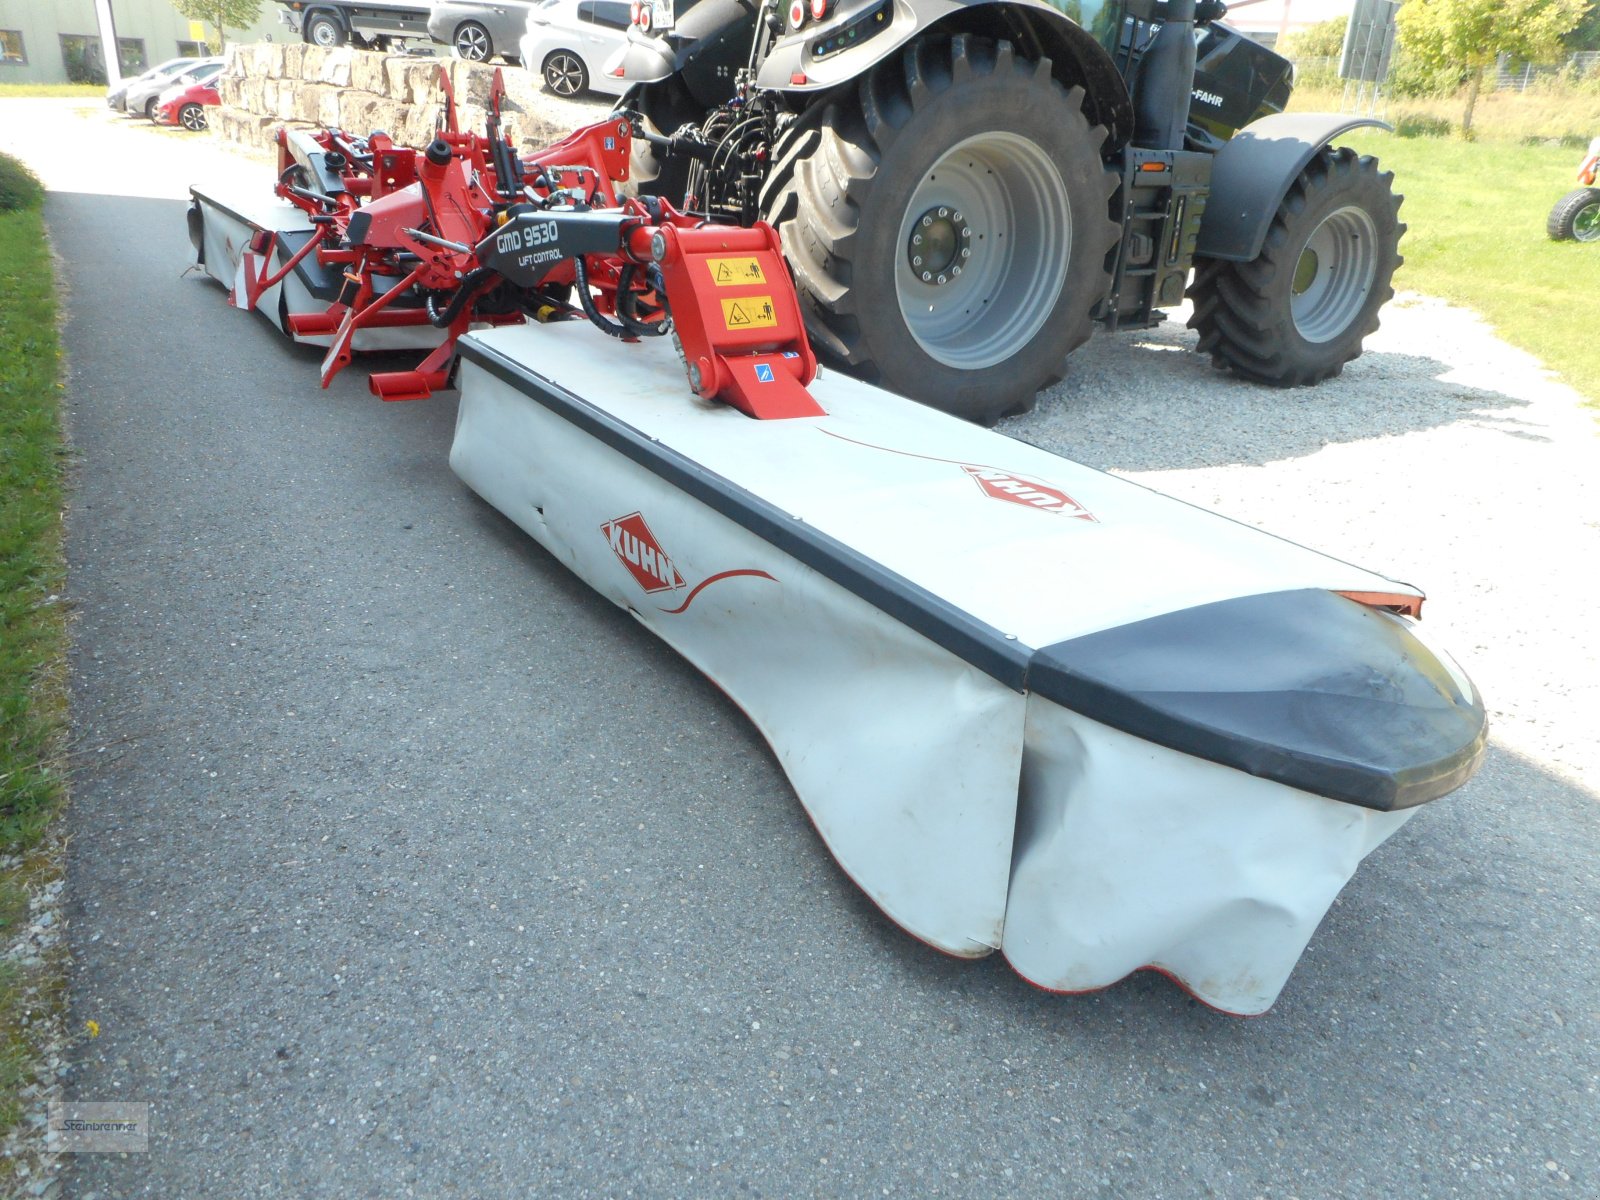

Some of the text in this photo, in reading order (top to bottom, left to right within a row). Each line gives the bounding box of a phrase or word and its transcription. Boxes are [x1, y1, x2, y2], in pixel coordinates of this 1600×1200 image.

[497, 220, 558, 254] GMD 9530
[519, 248, 563, 266] LIFT CONTROL
[964, 470, 1092, 518] KUHN
[608, 518, 677, 591] KUHN
